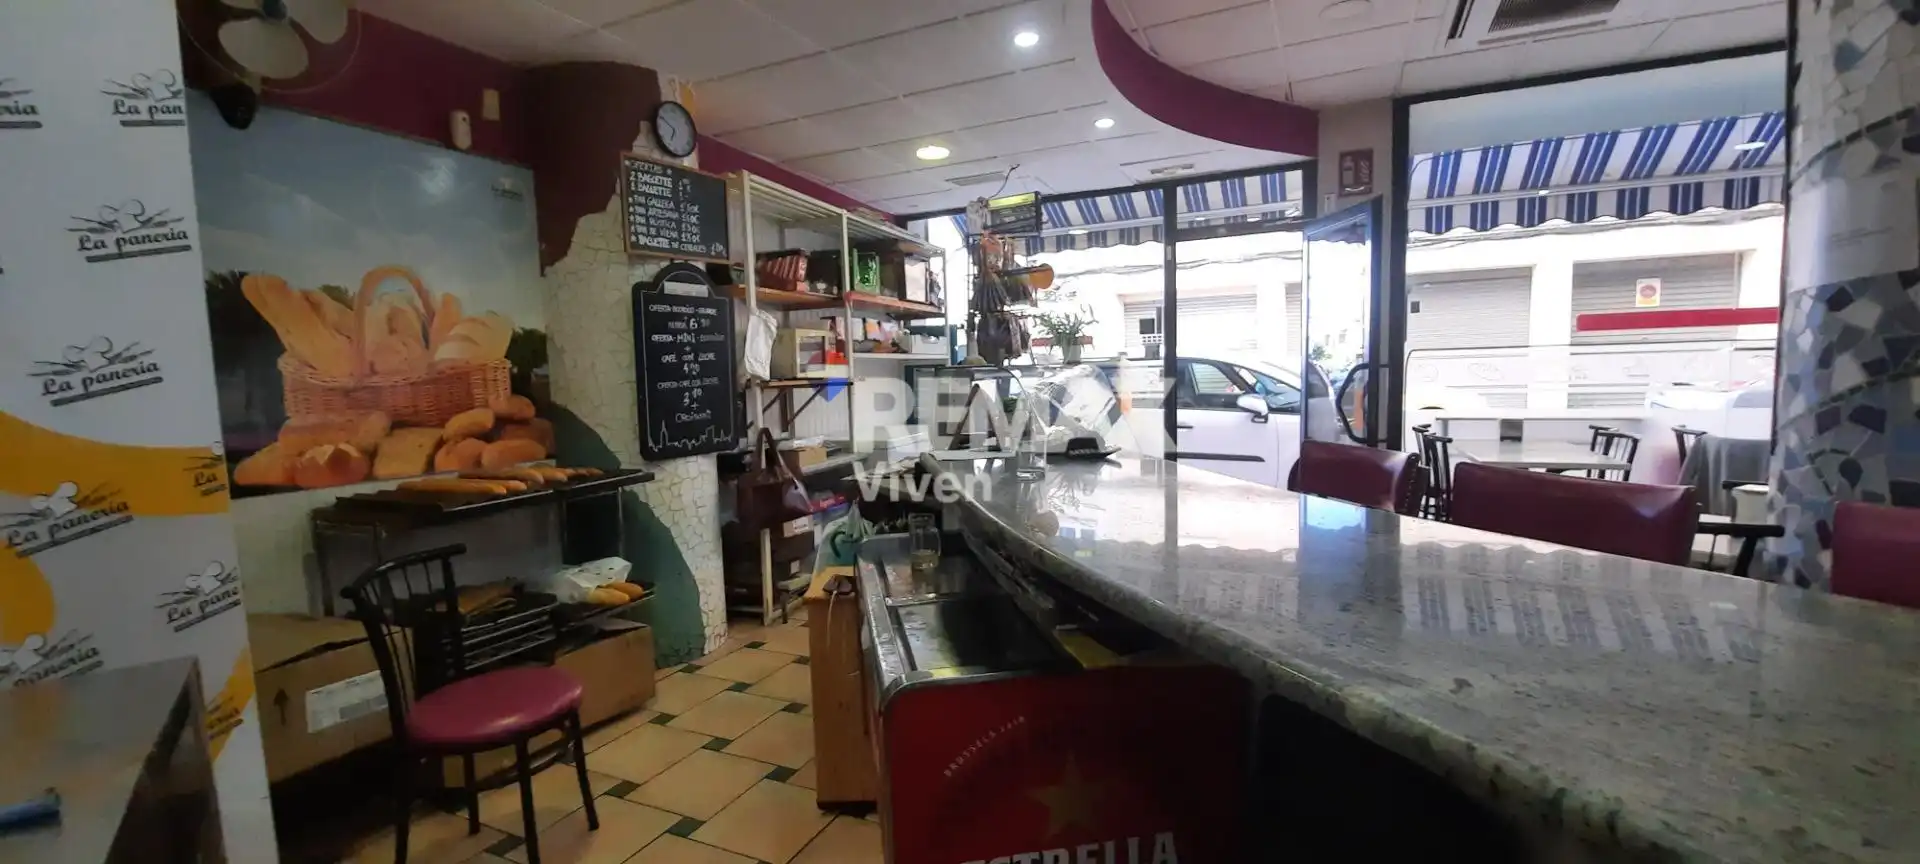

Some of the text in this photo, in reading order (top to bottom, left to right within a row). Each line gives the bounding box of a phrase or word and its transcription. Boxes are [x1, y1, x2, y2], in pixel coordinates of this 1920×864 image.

[112, 99, 142, 116] La
[629, 171, 636, 181] 2
[77, 229, 190, 254] La paneria
[41, 361, 161, 397] La paneria
[193, 471, 218, 488] La
[5, 500, 130, 549] La paneria
[166, 604, 193, 625] La
